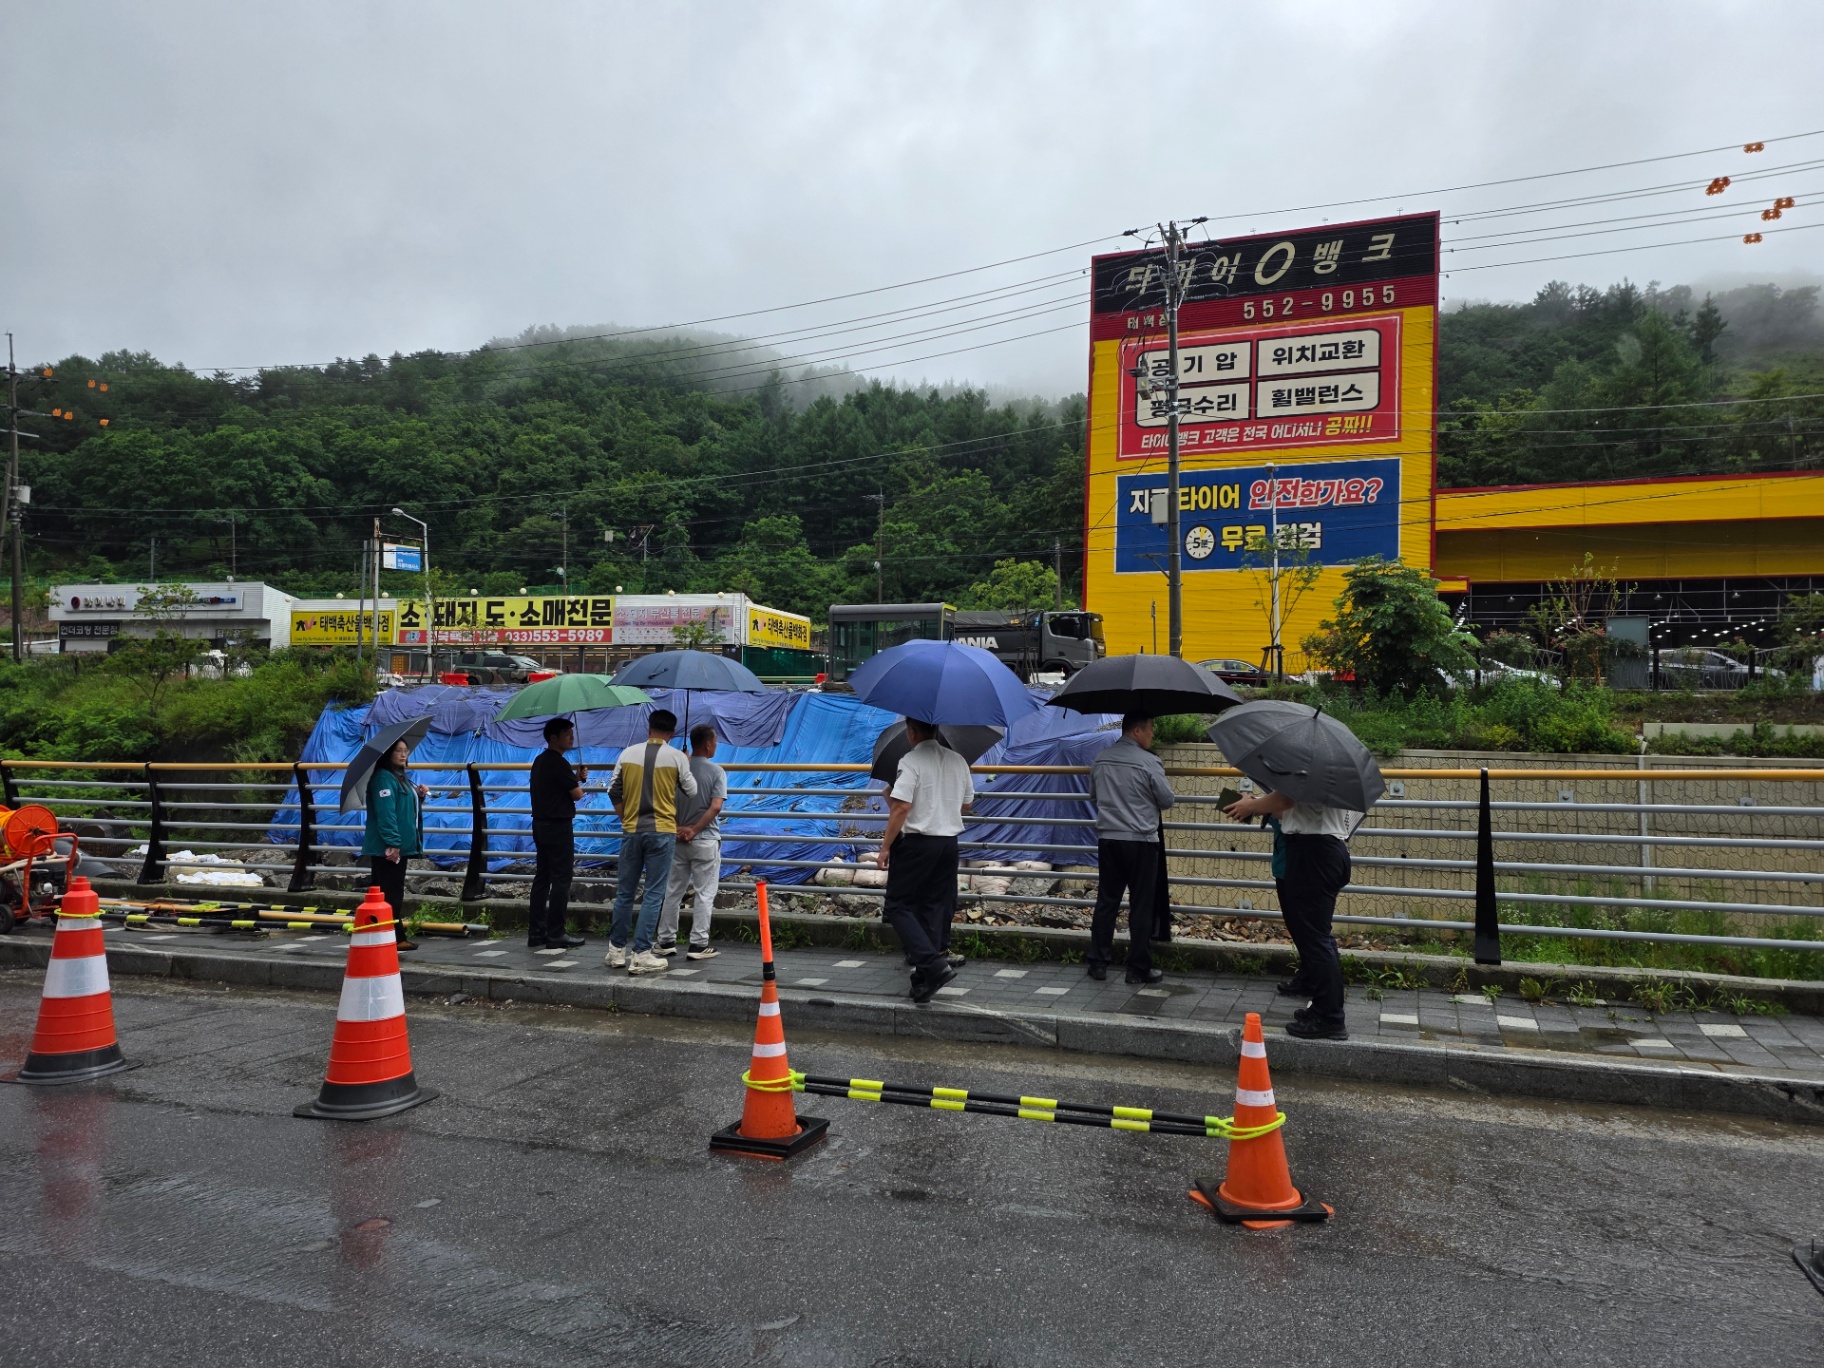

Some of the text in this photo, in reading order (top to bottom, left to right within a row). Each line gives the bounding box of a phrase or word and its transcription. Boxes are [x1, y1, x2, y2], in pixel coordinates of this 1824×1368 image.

[1243, 285, 1395, 320] 552-9955
[1150, 352, 1238, 377] 공기압
[1271, 339, 1366, 366] 위치교환
[1271, 383, 1364, 408] 휠밸런스
[1202, 427, 1240, 444] 고객은
[1243, 424, 1268, 440] 전국
[1270, 421, 1323, 440] 어디서나
[1325, 415, 1373, 436] 공짜!!
[1179, 483, 1240, 511] 타이어
[1248, 477, 1384, 510] 안전한가요?
